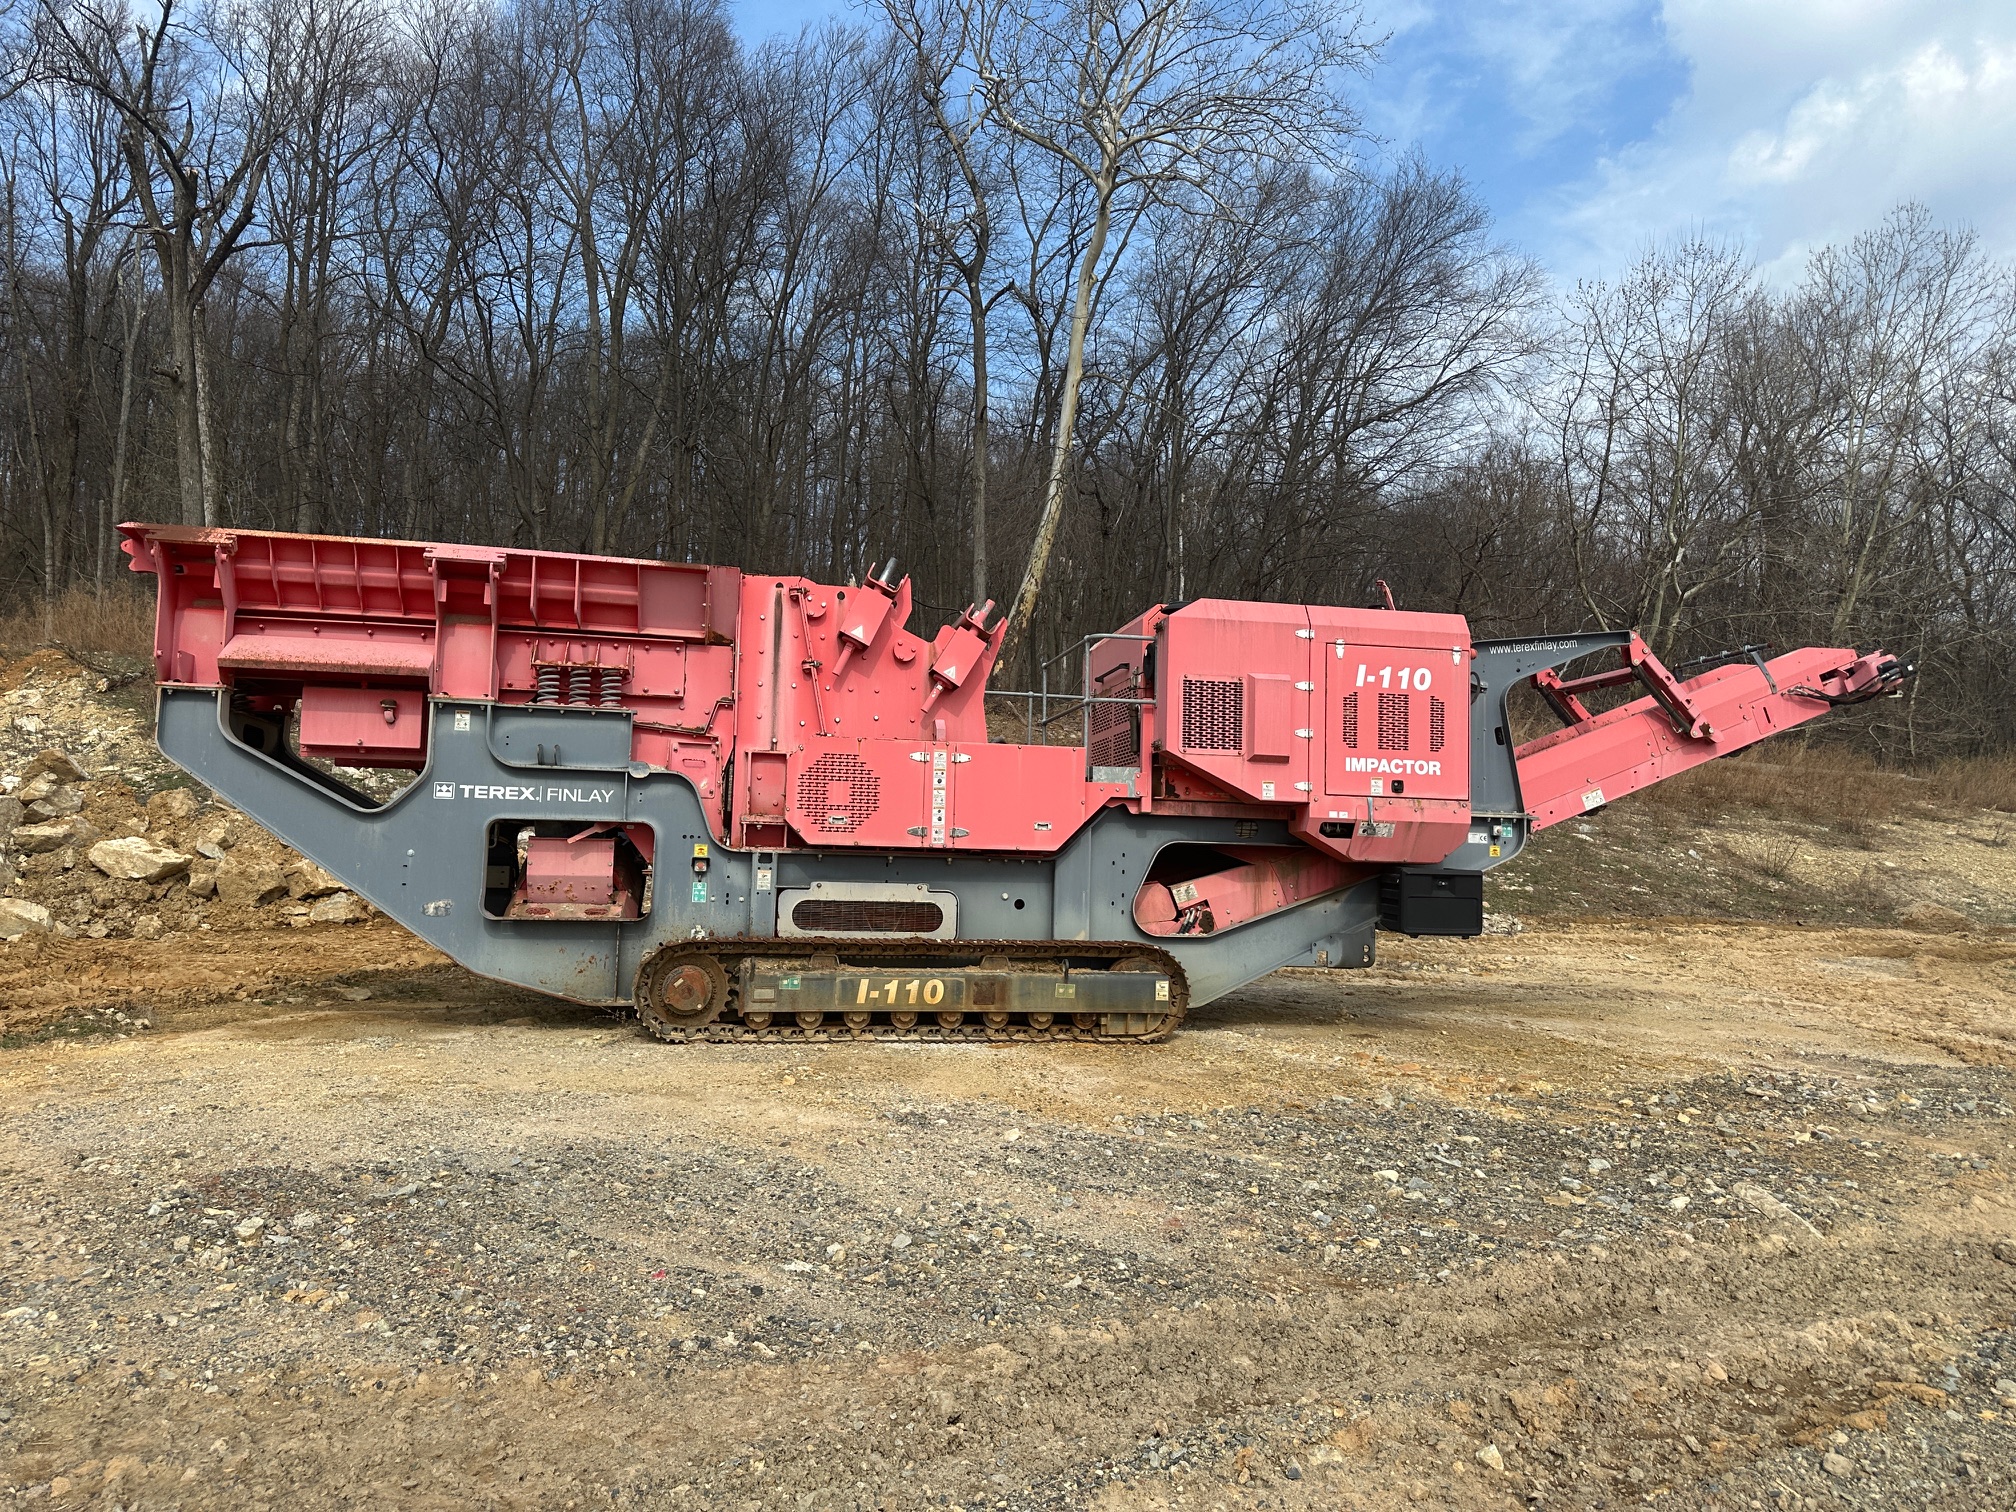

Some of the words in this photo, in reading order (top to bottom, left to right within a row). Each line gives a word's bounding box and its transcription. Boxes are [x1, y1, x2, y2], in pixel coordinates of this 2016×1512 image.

[1489, 640, 1578, 654] www.terexfinlay.com
[1355, 664, 1432, 691] I-110
[1345, 757, 1441, 775] IMPACTOR
[546, 787, 615, 803] FINLAY
[856, 978, 945, 1005] I-110
